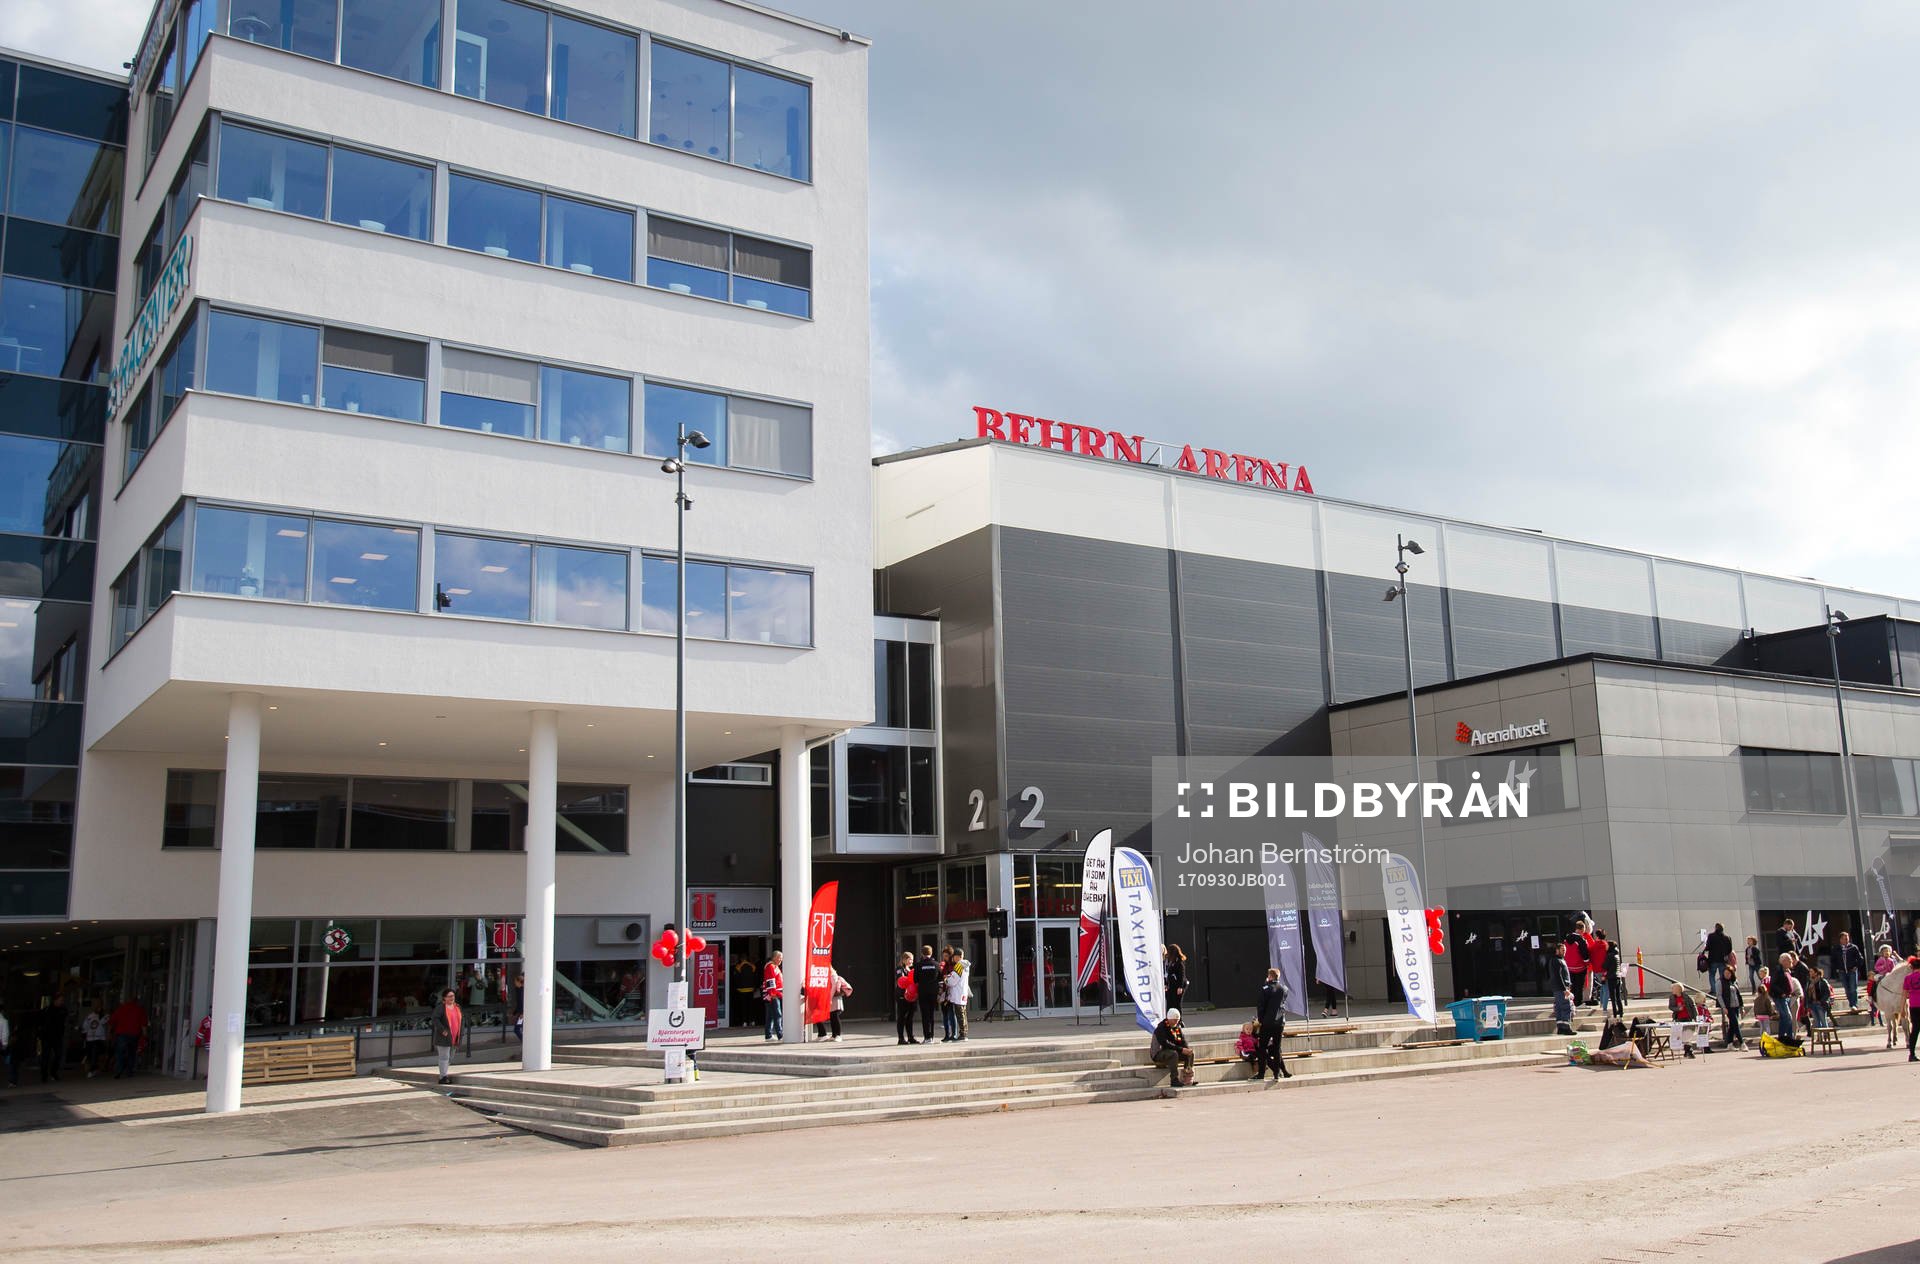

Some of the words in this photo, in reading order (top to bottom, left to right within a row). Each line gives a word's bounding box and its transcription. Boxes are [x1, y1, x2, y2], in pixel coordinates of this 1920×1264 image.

[972, 406, 1144, 464] BEHRN
[1177, 443, 1315, 494] ARENA
[1471, 719, 1549, 746] Arenahuset
[968, 788, 984, 831] 2
[1020, 786, 1045, 828] 2
[1086, 857, 1096, 868] DET
[1096, 858, 1106, 868] ÄR
[1091, 870, 1106, 880] SOM
[1121, 872, 1143, 887] TAXI
[1388, 869, 1406, 882] TAXI
[1089, 881, 1098, 890] ÄR
[1128, 890, 1152, 1004] TAXIVÄRD
[1405, 948, 1417, 967] 43
[1408, 972, 1421, 990] 00
